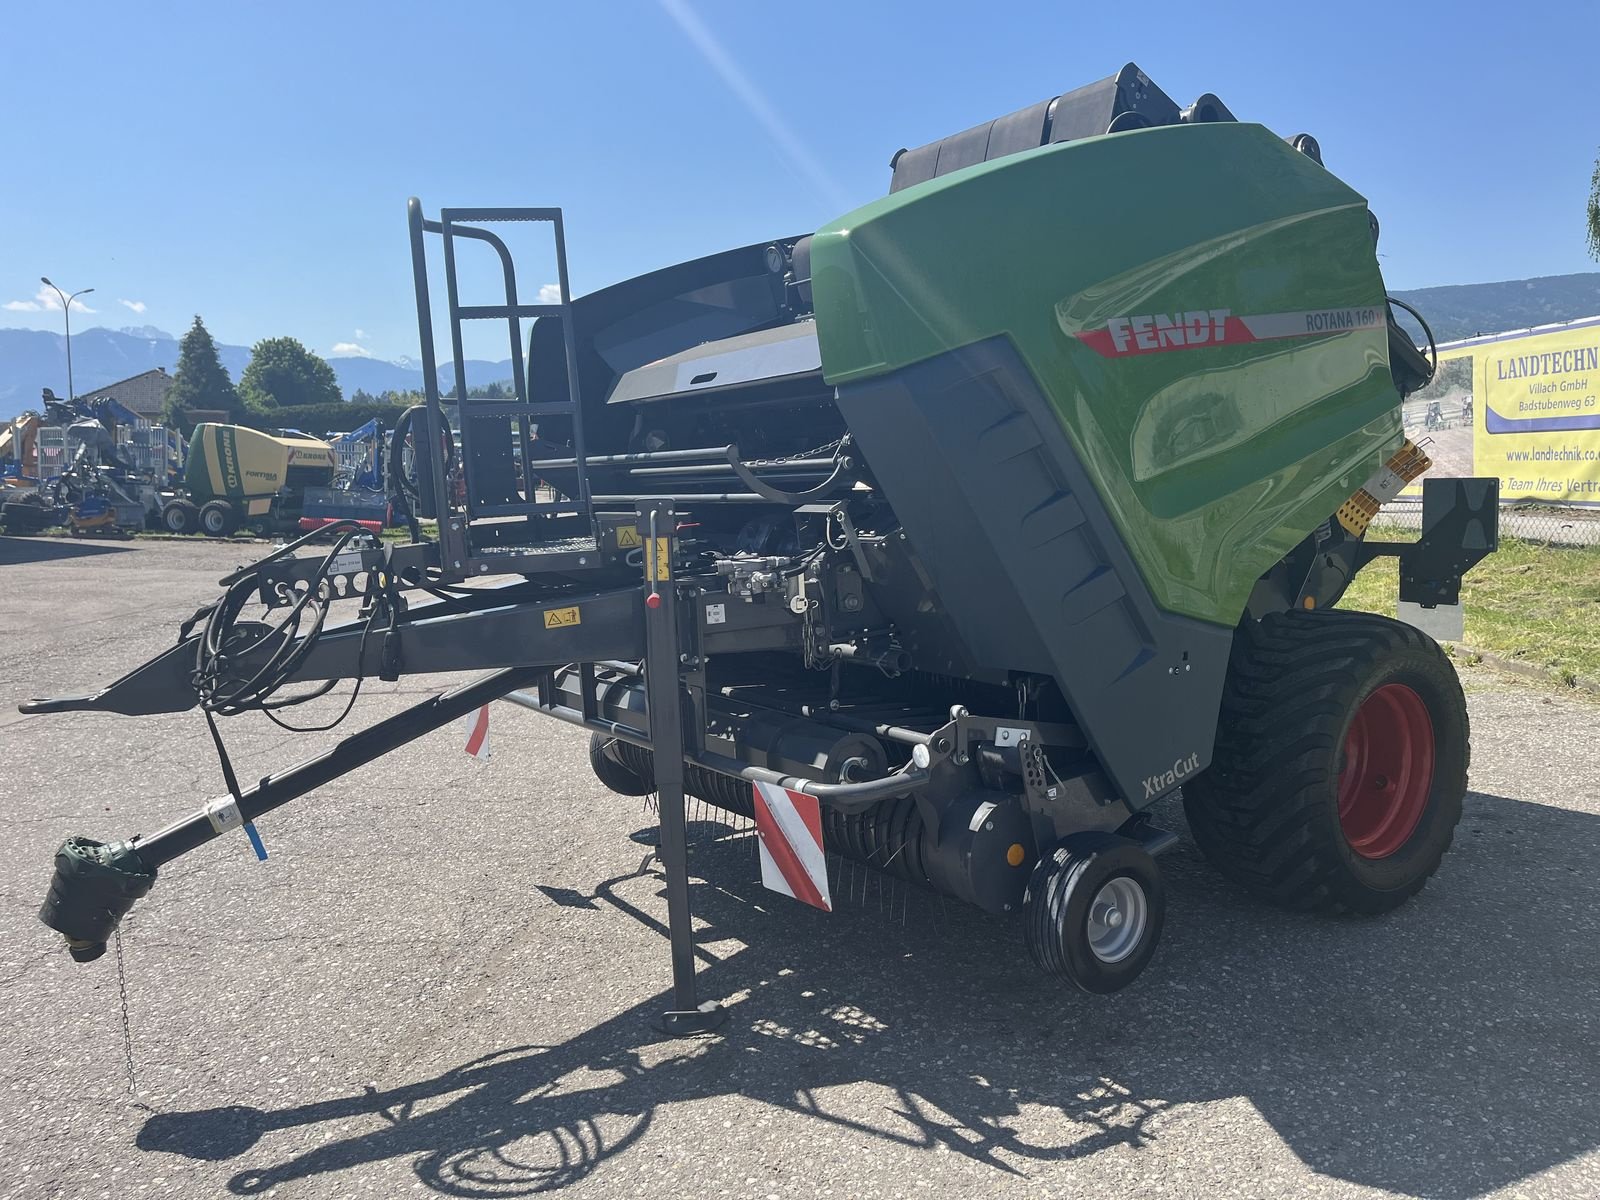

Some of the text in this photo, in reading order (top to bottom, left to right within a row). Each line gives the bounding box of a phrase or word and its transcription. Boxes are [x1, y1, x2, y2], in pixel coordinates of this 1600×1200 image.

[1305, 311, 1353, 332] ROTANA
[1356, 309, 1375, 327] 160
[1107, 308, 1231, 353] FENDT
[1529, 378, 1588, 395] Villach GmbH
[1519, 395, 1596, 412] Badstubenweg 63
[1506, 445, 1600, 461] www.landtechnik.co.
[1508, 477, 1534, 491] Team
[1536, 477, 1564, 492] Ihres
[1567, 478, 1600, 493] Vertr
[1142, 752, 1200, 799] XtraCut
